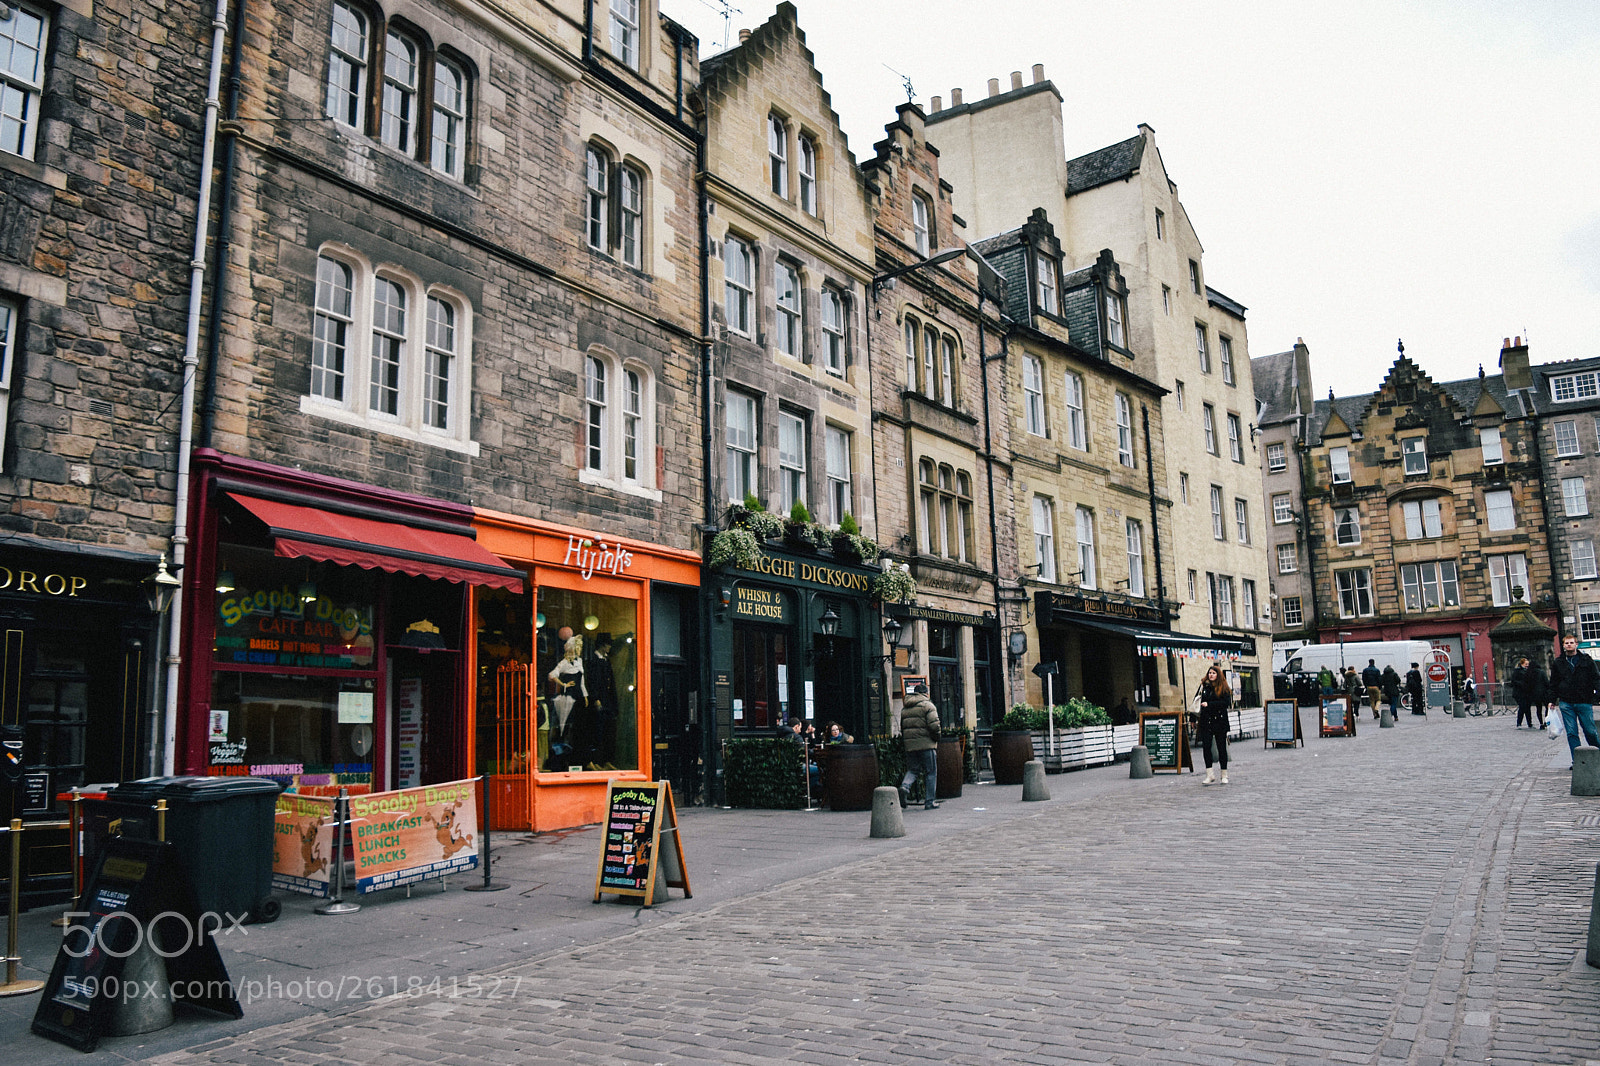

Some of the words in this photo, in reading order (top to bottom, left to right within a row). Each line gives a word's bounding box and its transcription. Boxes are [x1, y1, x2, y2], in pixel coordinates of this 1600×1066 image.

[564, 534, 633, 580] Hijinks
[736, 555, 796, 579] AGGIE
[802, 563, 869, 592] DICKSON'S
[219, 585, 305, 627] Scooby
[737, 588, 771, 603] WHISKY
[775, 593, 781, 604] &
[737, 602, 753, 616] ALE
[755, 604, 783, 620] HOUSE
[909, 608, 919, 616] THE
[919, 609, 945, 620] SMALLEST
[945, 612, 954, 621] PUB
[955, 614, 960, 622] IN
[960, 615, 984, 625] SCOTLAND
[258, 617, 297, 635] CAFE
[304, 620, 334, 637] BAR
[250, 638, 280, 650] BAGELS
[226, 765, 249, 776] DOGS
[250, 764, 304, 776] SANDWICHES
[337, 773, 371, 785] TOASTIES
[354, 791, 418, 817] Scooby
[425, 784, 470, 807] Doo's
[613, 789, 639, 804] Scooby
[638, 792, 656, 806] Doo's
[358, 816, 423, 838] BREAKFAST
[359, 835, 400, 852] LUNCH
[360, 848, 407, 868] SNACKS
[365, 880, 393, 893] ICE-CREAM
[459, 863, 475, 873] CAKES
[373, 874, 384, 884] HOT
[384, 871, 398, 882] DOGS
[399, 865, 432, 878] SANDWICHES
[433, 860, 451, 871] WRAPS
